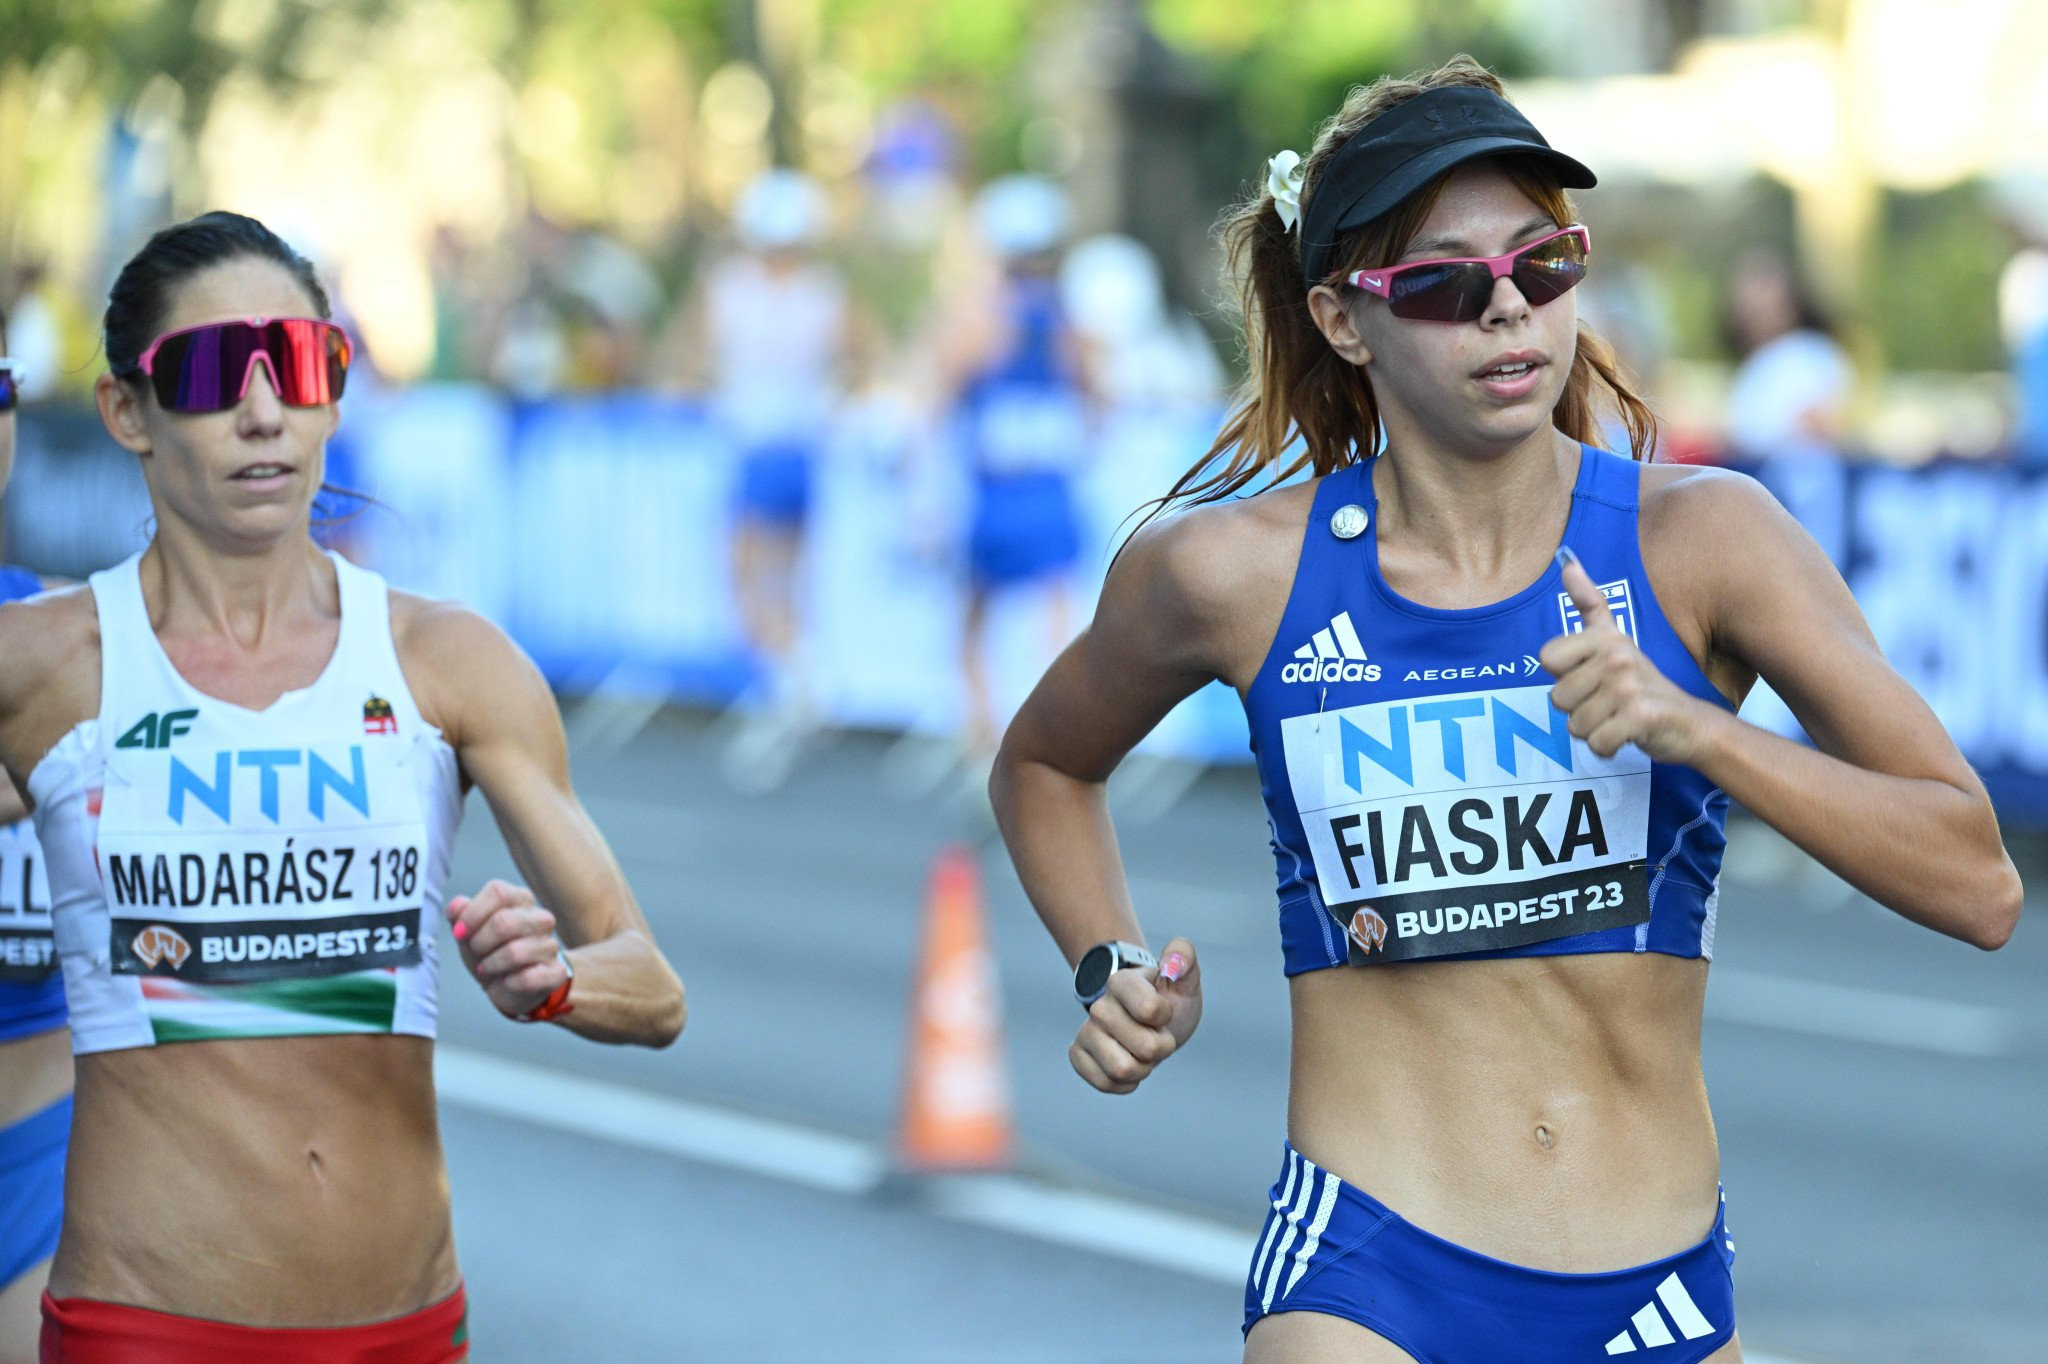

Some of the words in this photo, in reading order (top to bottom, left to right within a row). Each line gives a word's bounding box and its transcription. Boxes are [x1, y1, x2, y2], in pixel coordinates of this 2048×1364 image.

[1281, 656, 1382, 684] adidas
[1403, 661, 1516, 683] AEGEAN
[1339, 691, 1574, 795] NTN
[167, 745, 370, 826] NTN
[1329, 788, 1609, 891] FIASKA
[109, 838, 358, 907] MADARÁSZ
[370, 846, 418, 901] 138
[1395, 889, 1580, 939] BUDAPEST
[1583, 881, 1624, 912] 23
[201, 929, 370, 963] BUDAPEST
[373, 925, 407, 952] 23
